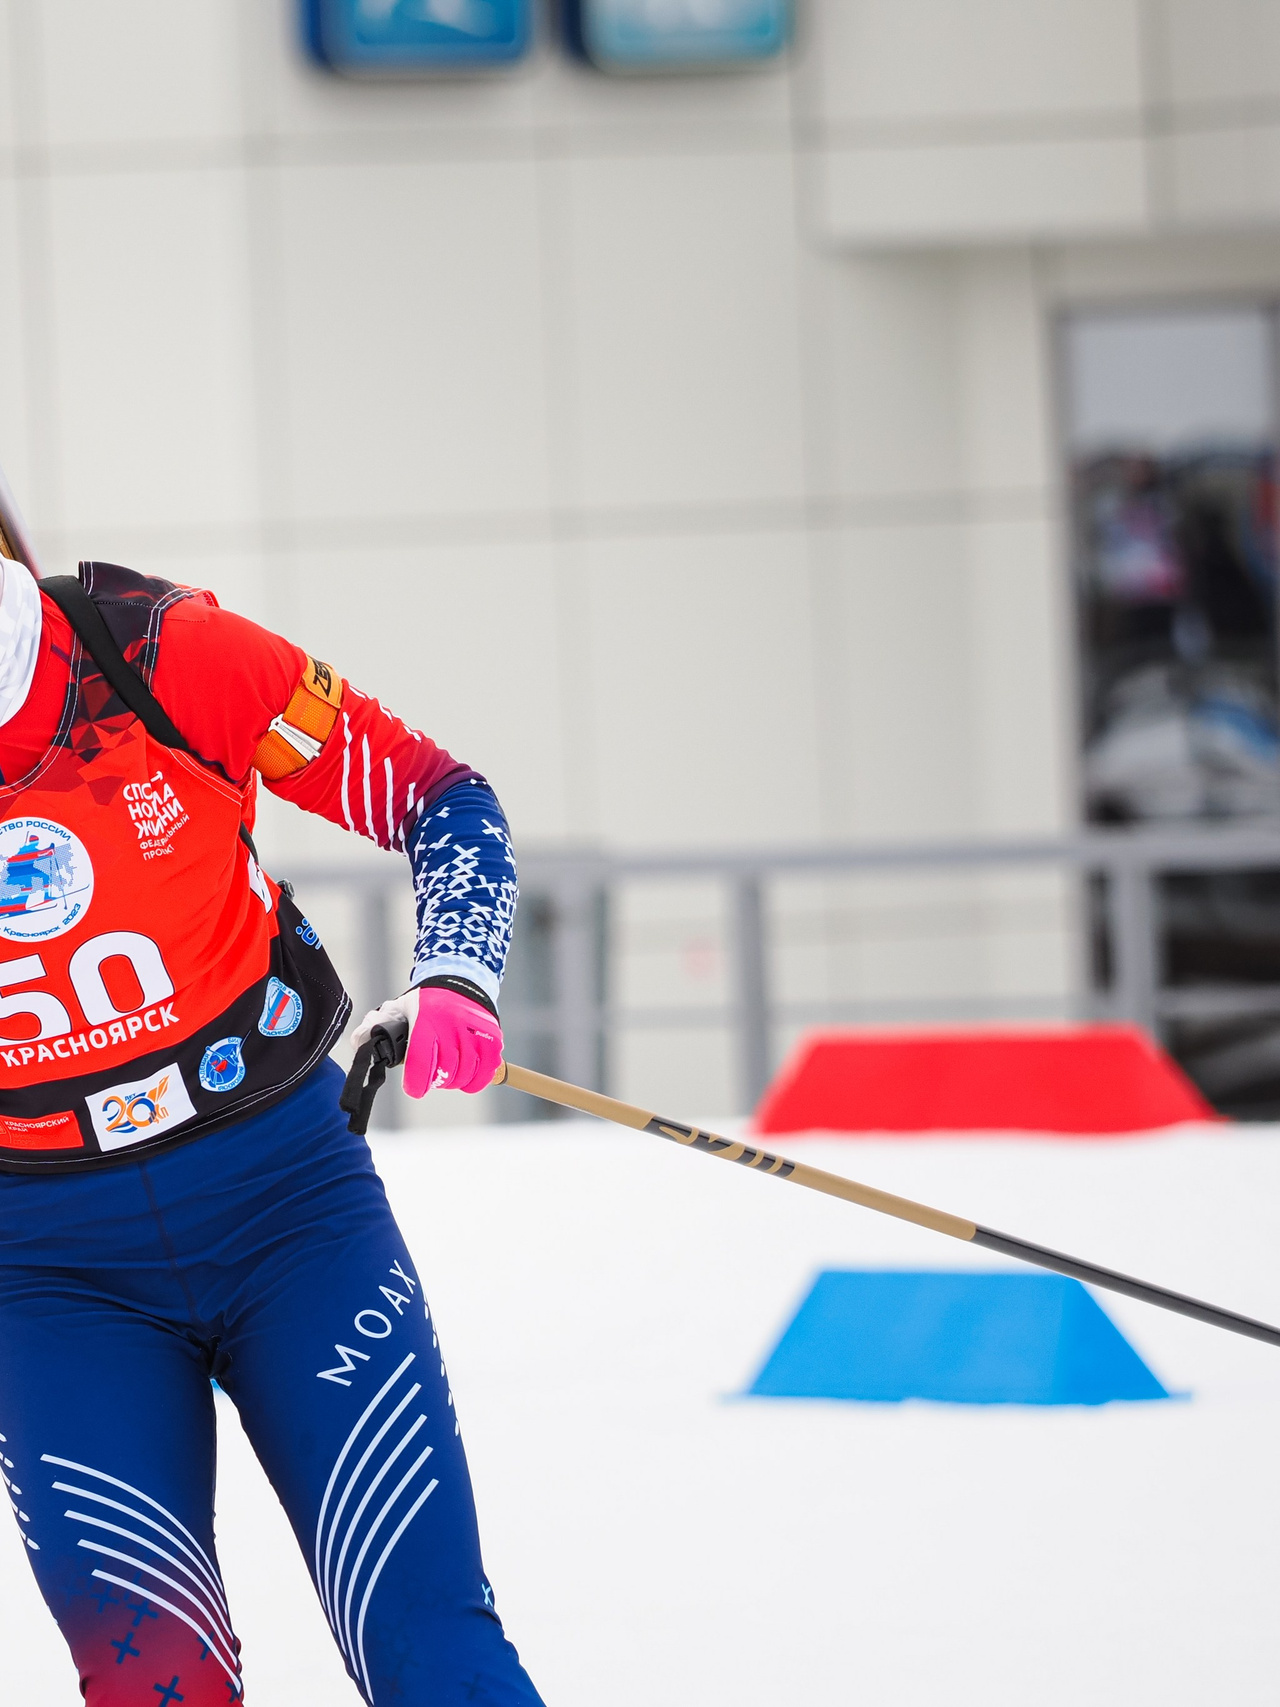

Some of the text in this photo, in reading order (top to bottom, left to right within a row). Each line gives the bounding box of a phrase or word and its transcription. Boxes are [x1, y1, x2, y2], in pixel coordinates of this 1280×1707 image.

[26, 820, 72, 842] РОССИИ
[3, 925, 61, 938] Красноярск
[61, 902, 81, 926] 2023
[0, 1001, 180, 1068] КРАСНОЯРСК
[3, 1115, 70, 1129] КРАСНОЯРСКИЙ
[102, 1095, 157, 1134] 20
[316, 1259, 417, 1387] MOAX
